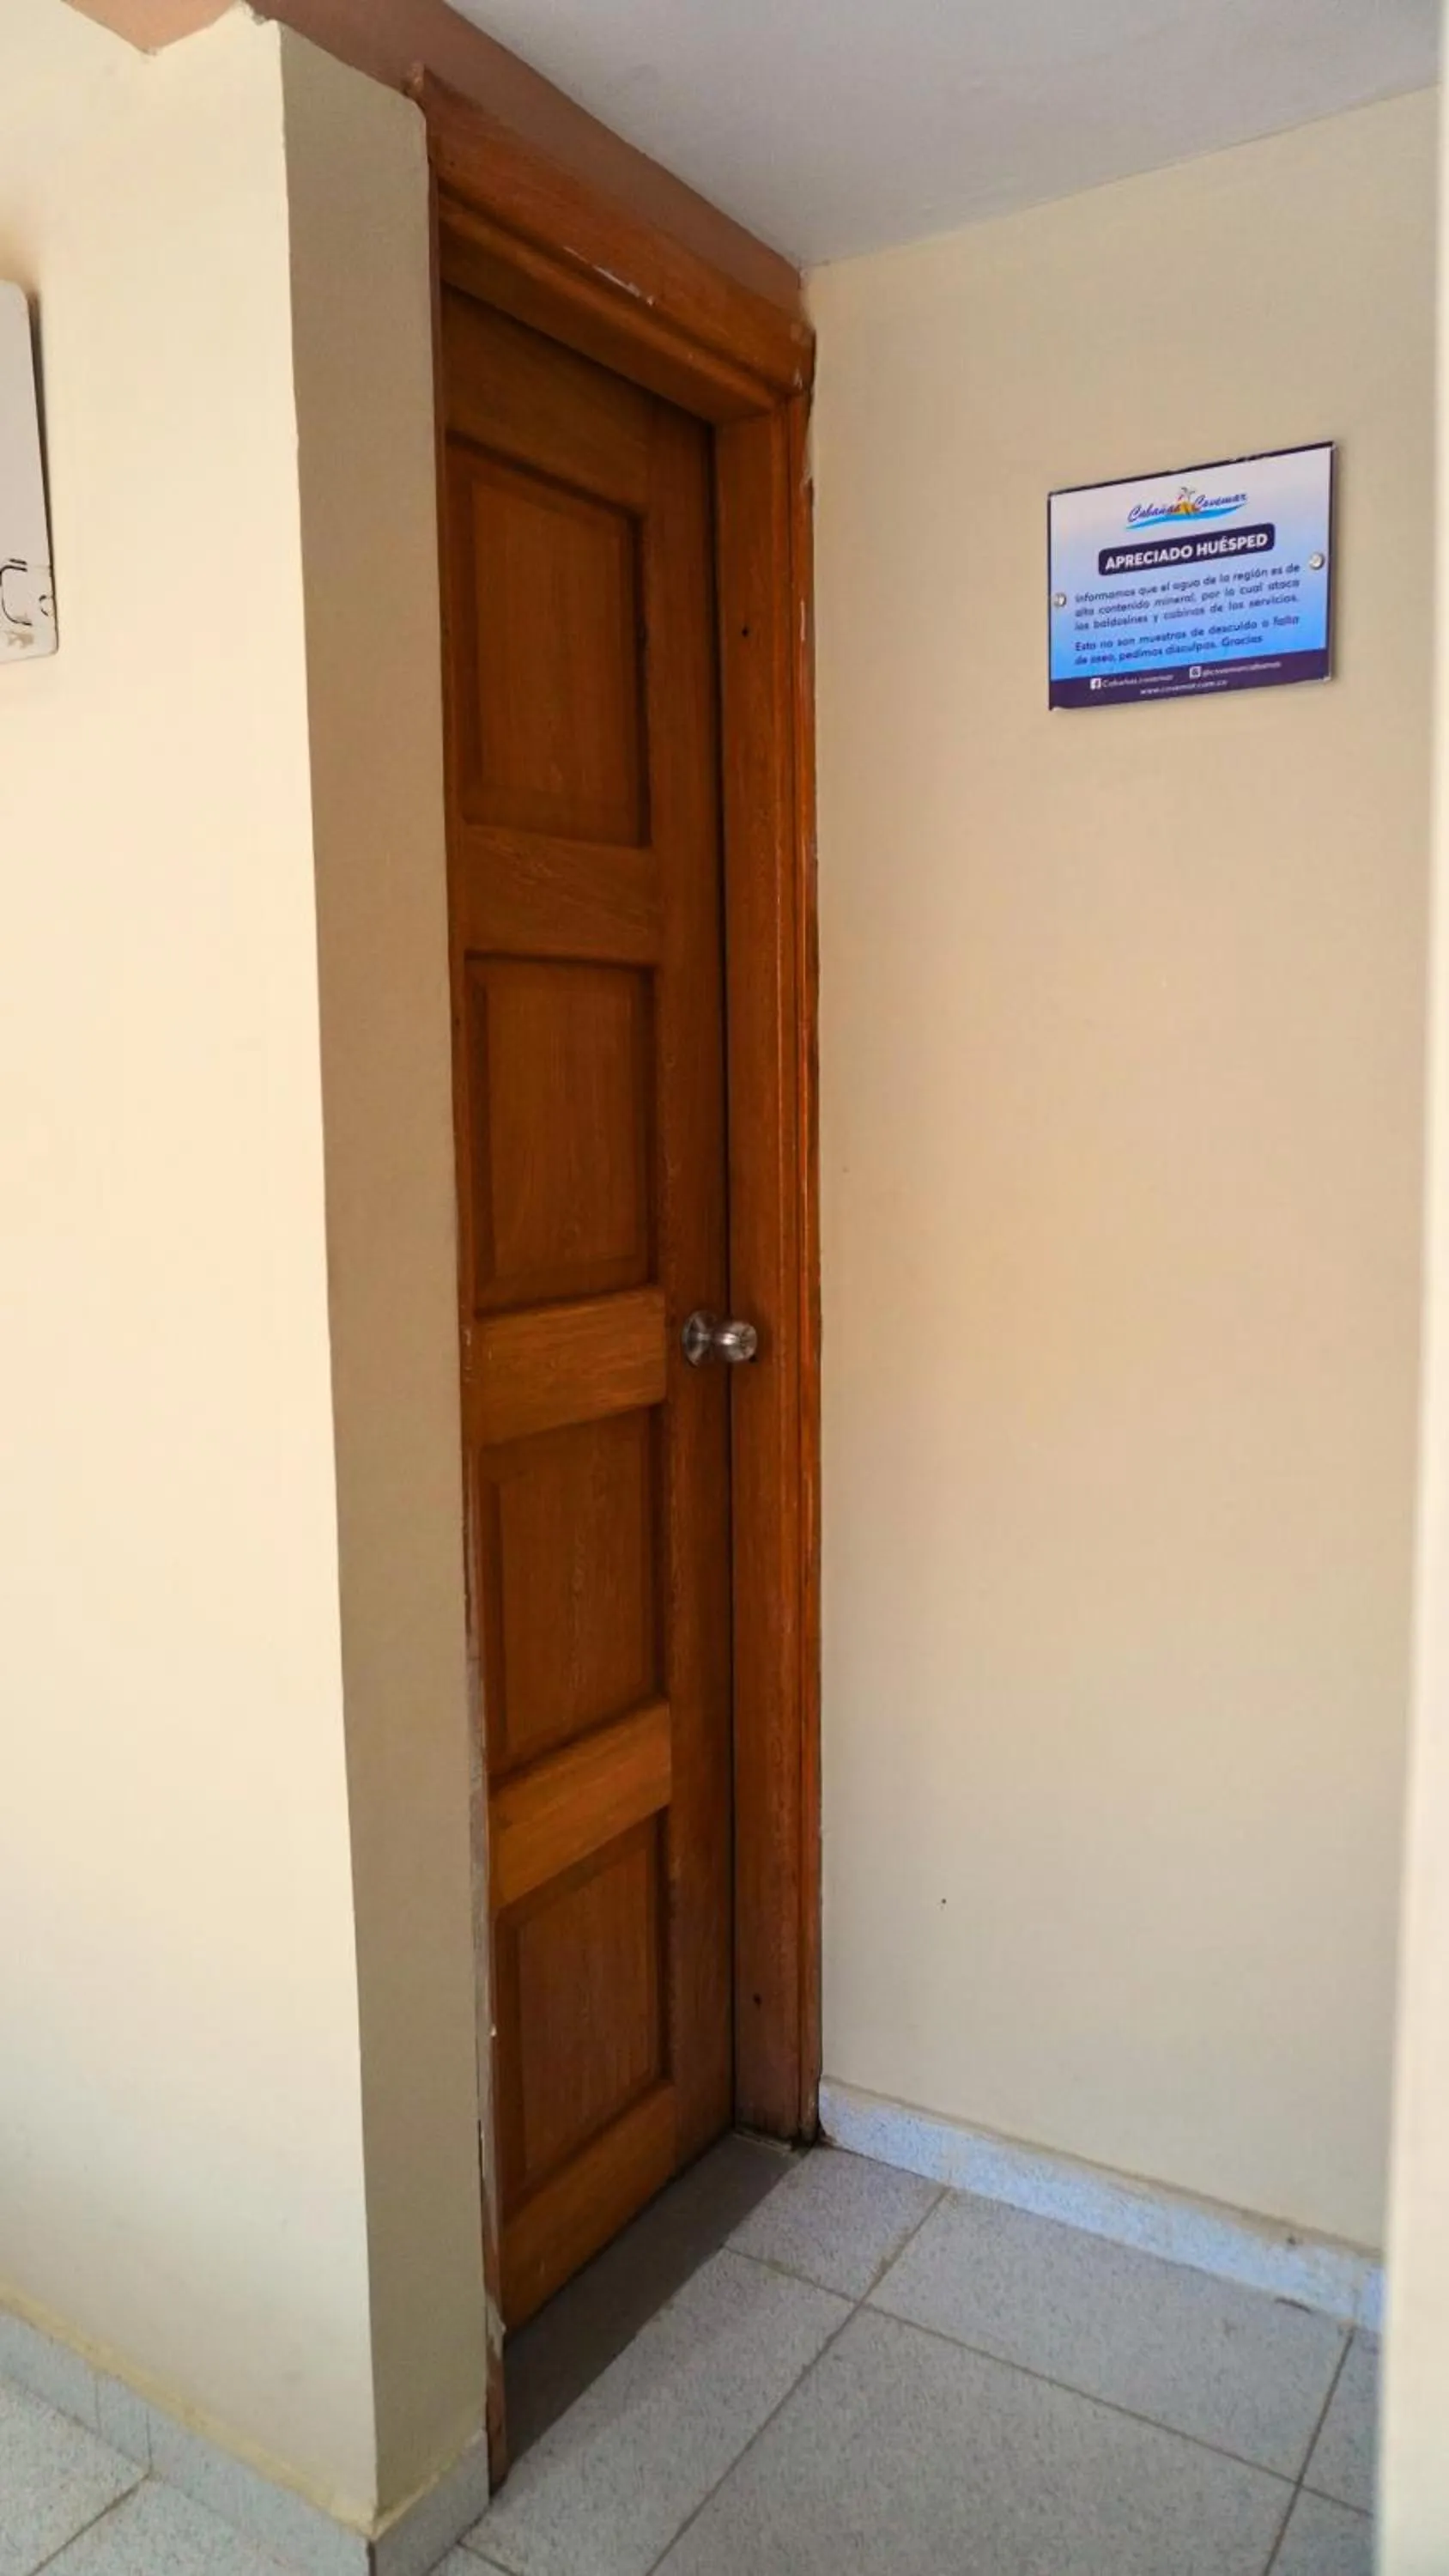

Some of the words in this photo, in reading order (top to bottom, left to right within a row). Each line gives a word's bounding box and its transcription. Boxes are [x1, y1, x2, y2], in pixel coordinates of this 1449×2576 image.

[1104, 544, 1192, 571] APRECIADO
[1196, 532, 1269, 556] HUÉSPED
[1137, 586, 1158, 596] que
[1160, 581, 1170, 592] el
[1172, 579, 1201, 592] agua
[1203, 576, 1216, 586] de
[1219, 573, 1230, 583] la
[1233, 568, 1268, 582] región
[1271, 566, 1283, 575] es
[1285, 562, 1300, 574] de
[1098, 600, 1150, 615] contenido
[1201, 590, 1221, 602] por
[1239, 582, 1263, 595] cual
[1268, 580, 1300, 592] ataca
[1153, 614, 1159, 623] y
[1210, 603, 1223, 613] de
[1228, 600, 1244, 611] los
[1075, 655, 1088, 665] de
[1119, 647, 1163, 663] pedimos
[1222, 635, 1263, 647] Gracias
[1100, 640, 1113, 648] no
[1117, 637, 1136, 647] son
[1139, 630, 1186, 644] muestras
[1190, 628, 1204, 637] de
[1208, 620, 1258, 635] descuido
